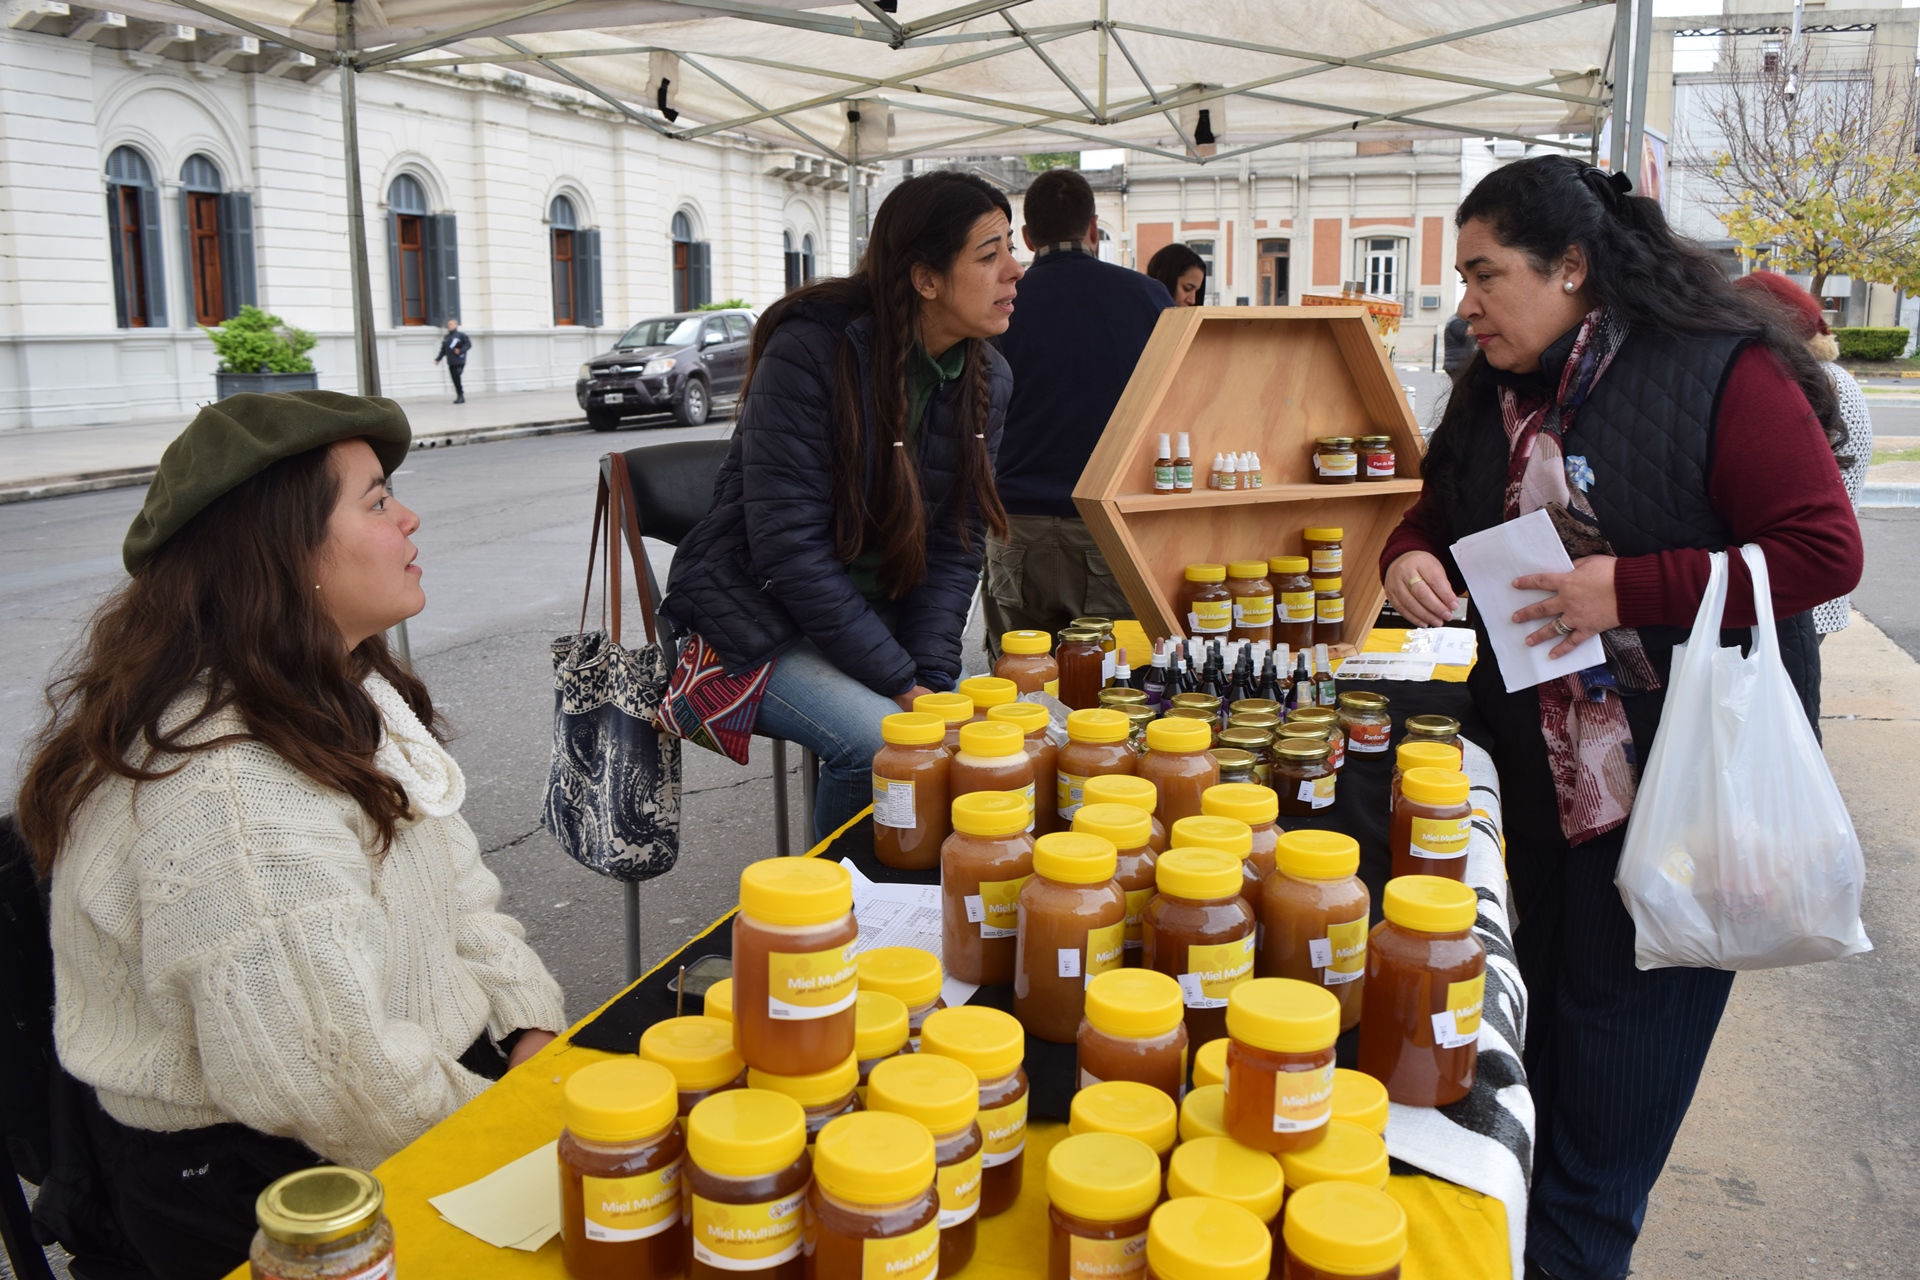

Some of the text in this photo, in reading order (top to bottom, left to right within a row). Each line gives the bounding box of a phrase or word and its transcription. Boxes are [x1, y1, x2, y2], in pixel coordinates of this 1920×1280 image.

[1422, 833, 1439, 842] Miel
[989, 902, 1011, 914] Miel
[1126, 914, 1137, 924] iel
[1096, 949, 1115, 963] Miel
[1336, 946, 1355, 958] Miel
[1199, 969, 1222, 981] Miel
[786, 976, 816, 990] Miel
[1456, 1003, 1475, 1019] Miel
[1282, 1094, 1309, 1107] Miel
[989, 1125, 1011, 1141] Miel
[955, 1181, 974, 1197] Miel
[602, 1200, 631, 1213] Miel
[708, 1215, 799, 1240] Miel Multifloral
[886, 1256, 913, 1274] Miel
[1076, 1260, 1104, 1275] Miel
